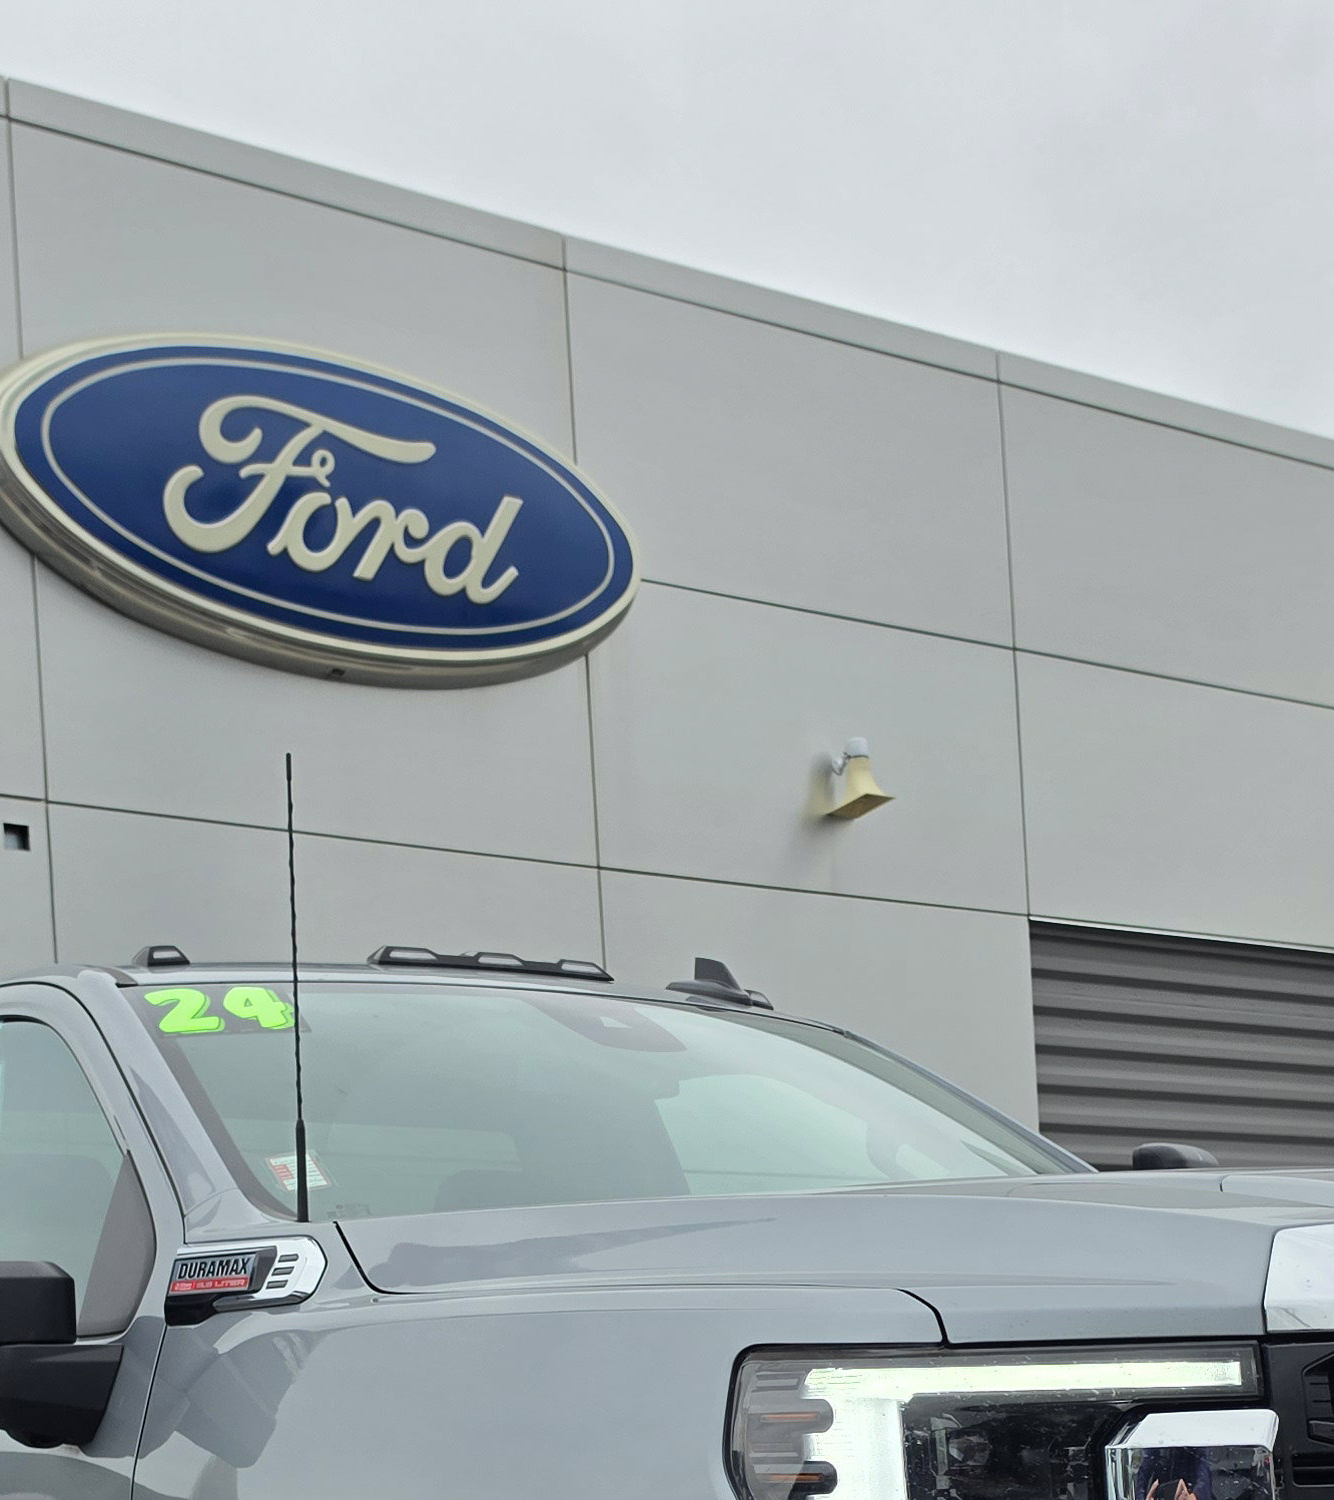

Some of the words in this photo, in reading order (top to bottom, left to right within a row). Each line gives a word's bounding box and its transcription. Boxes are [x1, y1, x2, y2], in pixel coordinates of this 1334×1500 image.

[161, 395, 525, 605] Ford
[144, 986, 296, 1034] 24
[178, 1257, 251, 1280] DURAMAX
